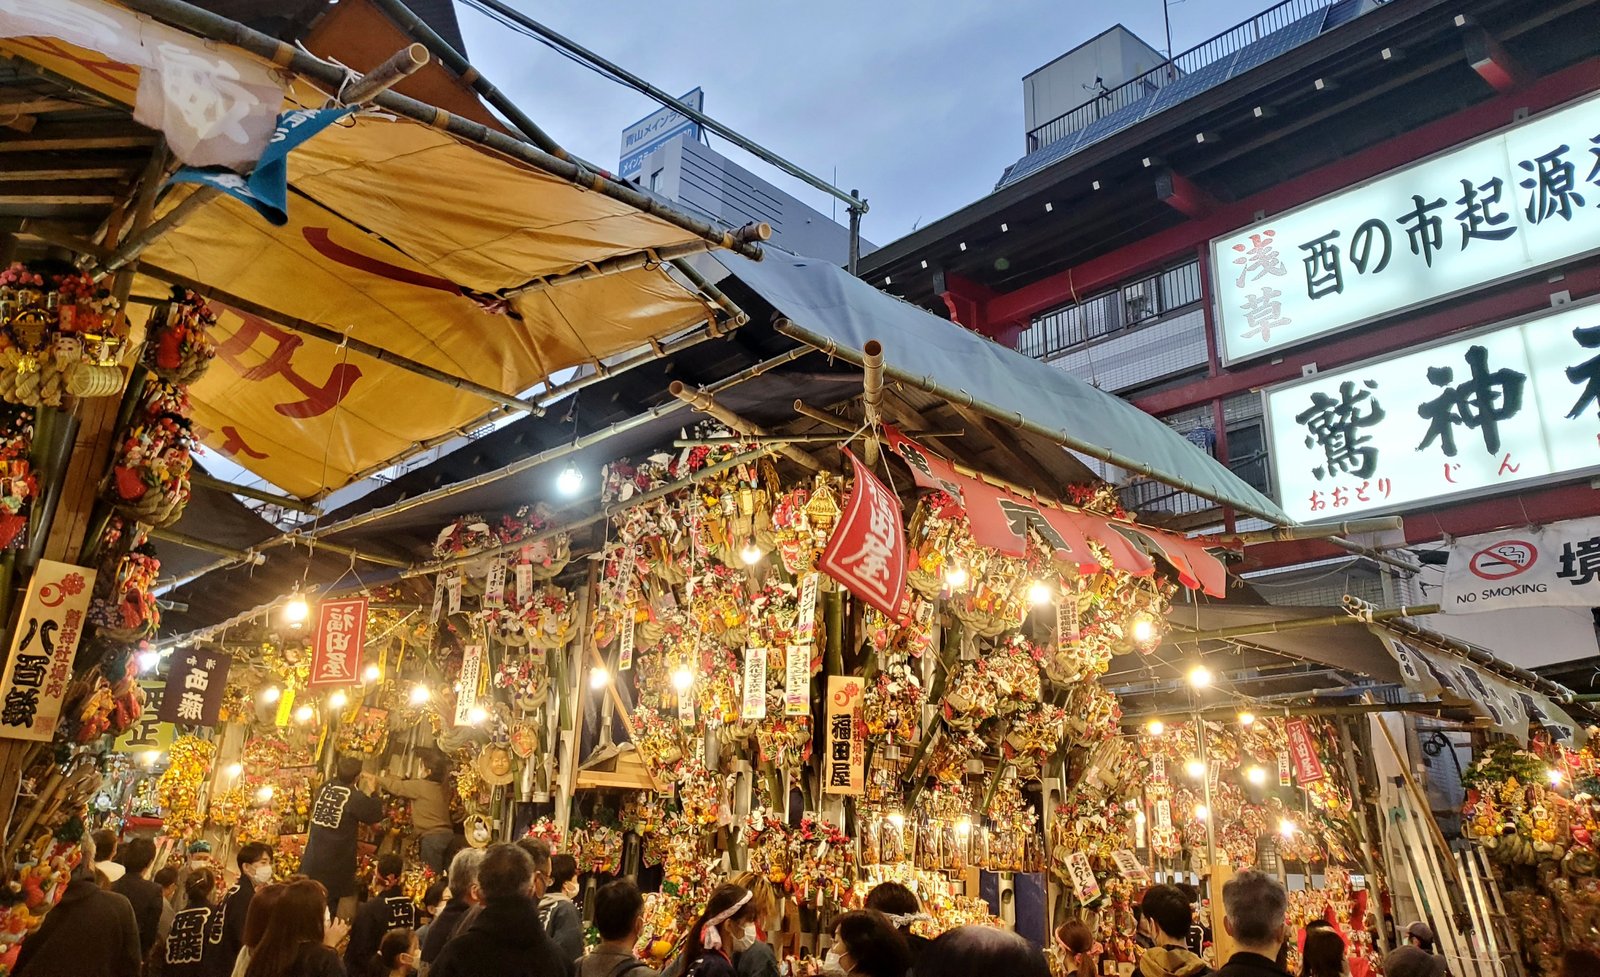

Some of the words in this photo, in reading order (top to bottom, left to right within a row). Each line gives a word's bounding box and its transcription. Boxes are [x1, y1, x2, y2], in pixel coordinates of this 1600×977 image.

[1231, 229, 1292, 342] 浅草
[1309, 478, 1391, 511] おおとり
[1456, 592, 1477, 604] NO
[1481, 583, 1548, 600] SMOKING
[831, 713, 851, 787] 福田屋
